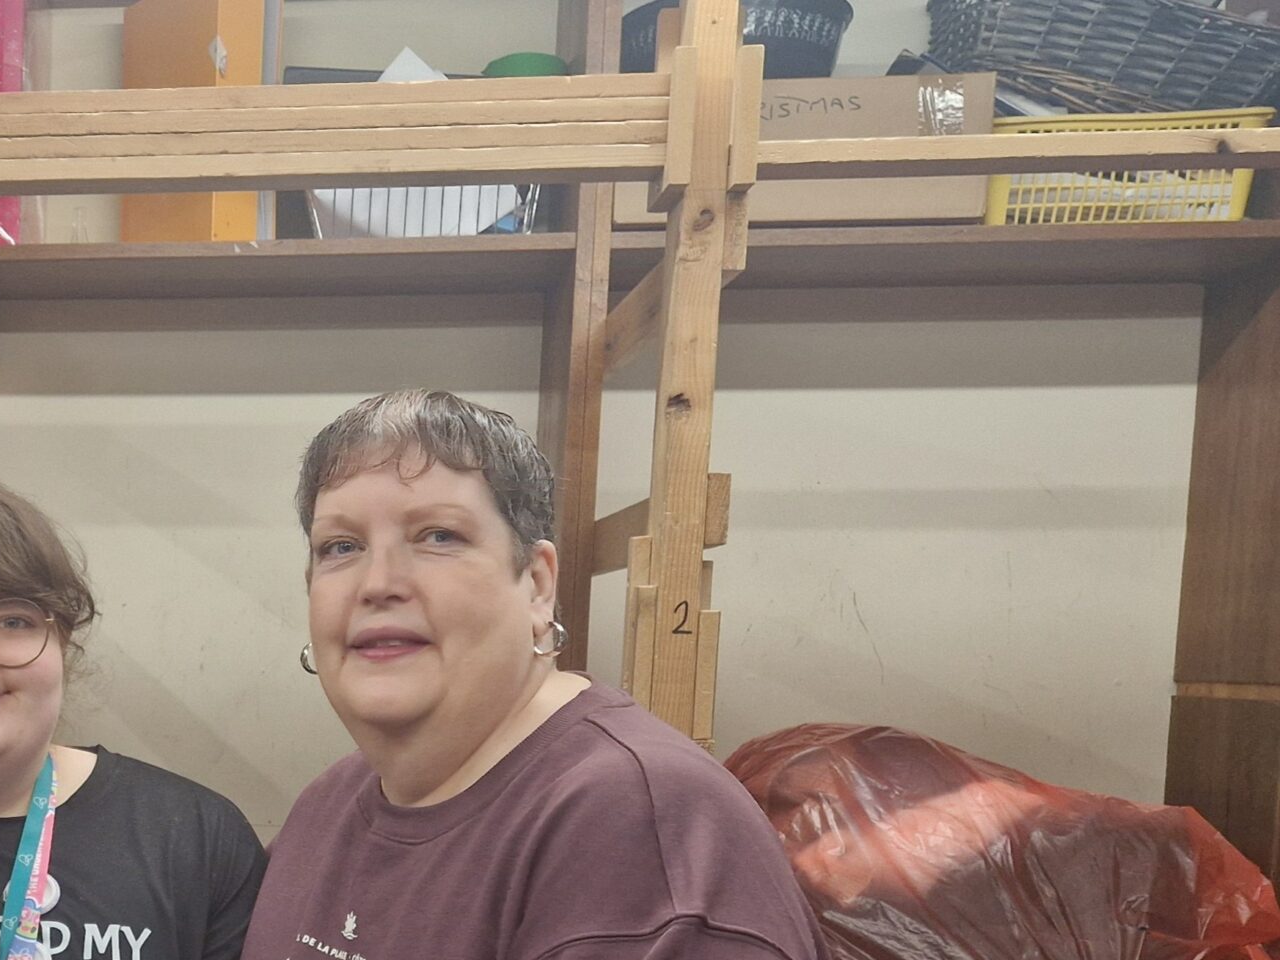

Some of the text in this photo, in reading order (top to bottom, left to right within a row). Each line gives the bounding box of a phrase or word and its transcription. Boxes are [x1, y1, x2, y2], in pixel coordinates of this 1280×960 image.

[760, 95, 862, 121] RISTMAS
[671, 600, 693, 635] 2
[301, 934, 318, 948] DE
[316, 941, 331, 955] LA
